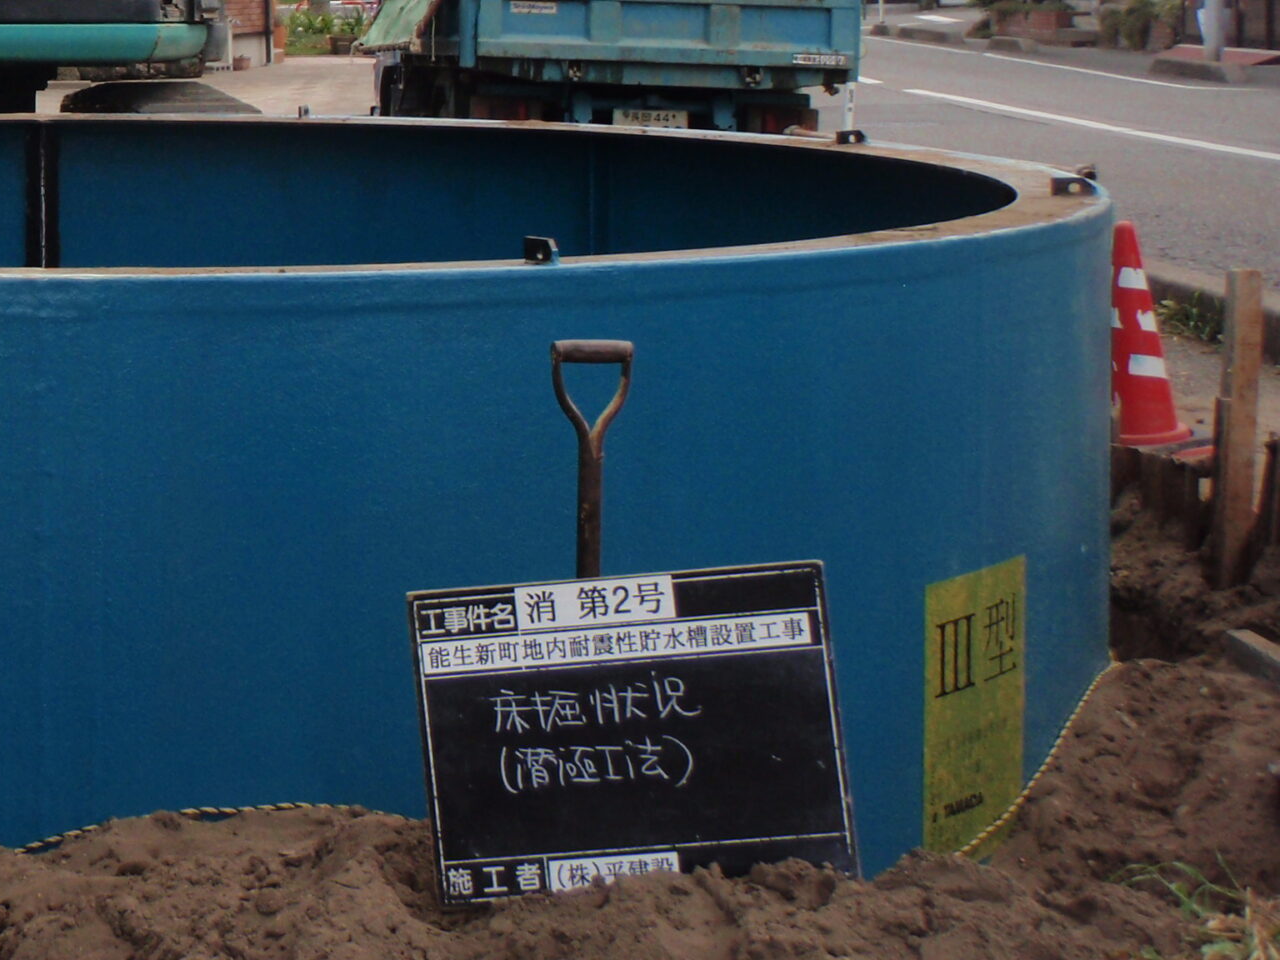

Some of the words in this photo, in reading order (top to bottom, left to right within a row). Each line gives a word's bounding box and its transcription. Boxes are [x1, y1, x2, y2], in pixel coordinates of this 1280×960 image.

[420, 602, 516, 635] 工事件名
[524, 590, 557, 624] 消
[576, 581, 665, 620] 第2号
[427, 617, 805, 670] 能生新町地内耐震性貯水槽設置工事
[446, 861, 542, 897] 施工者
